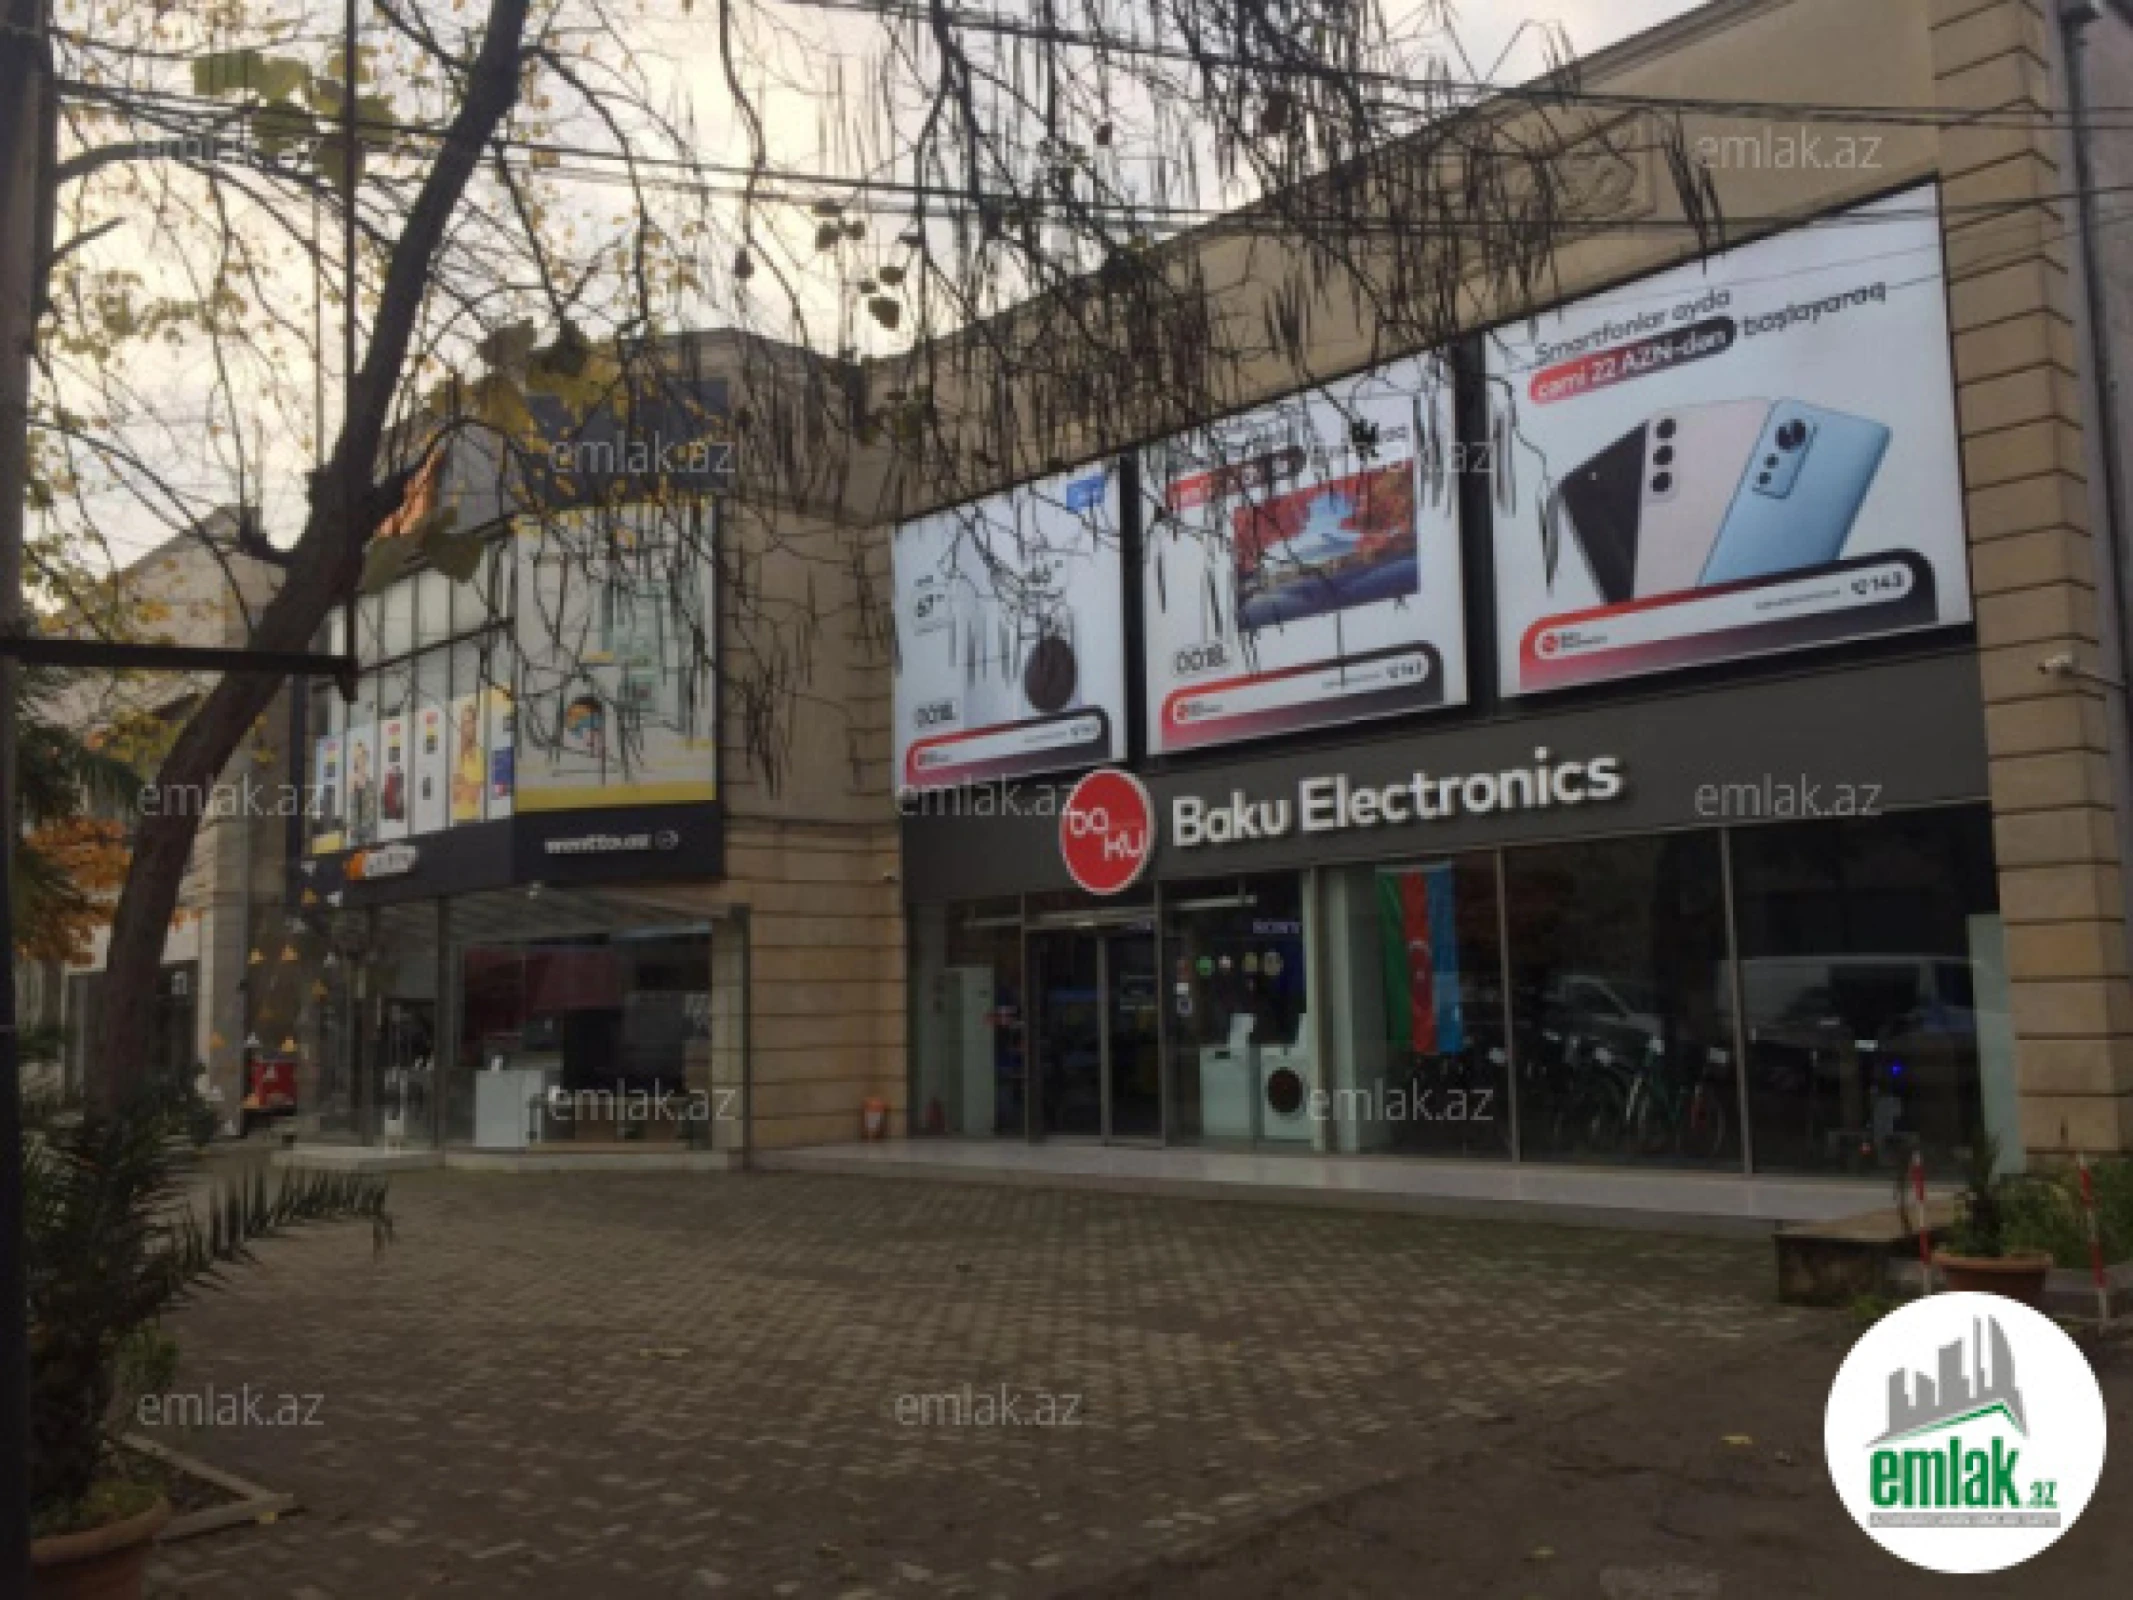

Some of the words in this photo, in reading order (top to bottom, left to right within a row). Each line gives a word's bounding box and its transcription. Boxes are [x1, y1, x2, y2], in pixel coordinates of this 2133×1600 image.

[1535, 309, 1667, 364] Smartfonlar
[1671, 288, 1731, 322] ayda
[1173, 789, 1291, 847] Baku
[1299, 746, 1624, 831] Electronics
